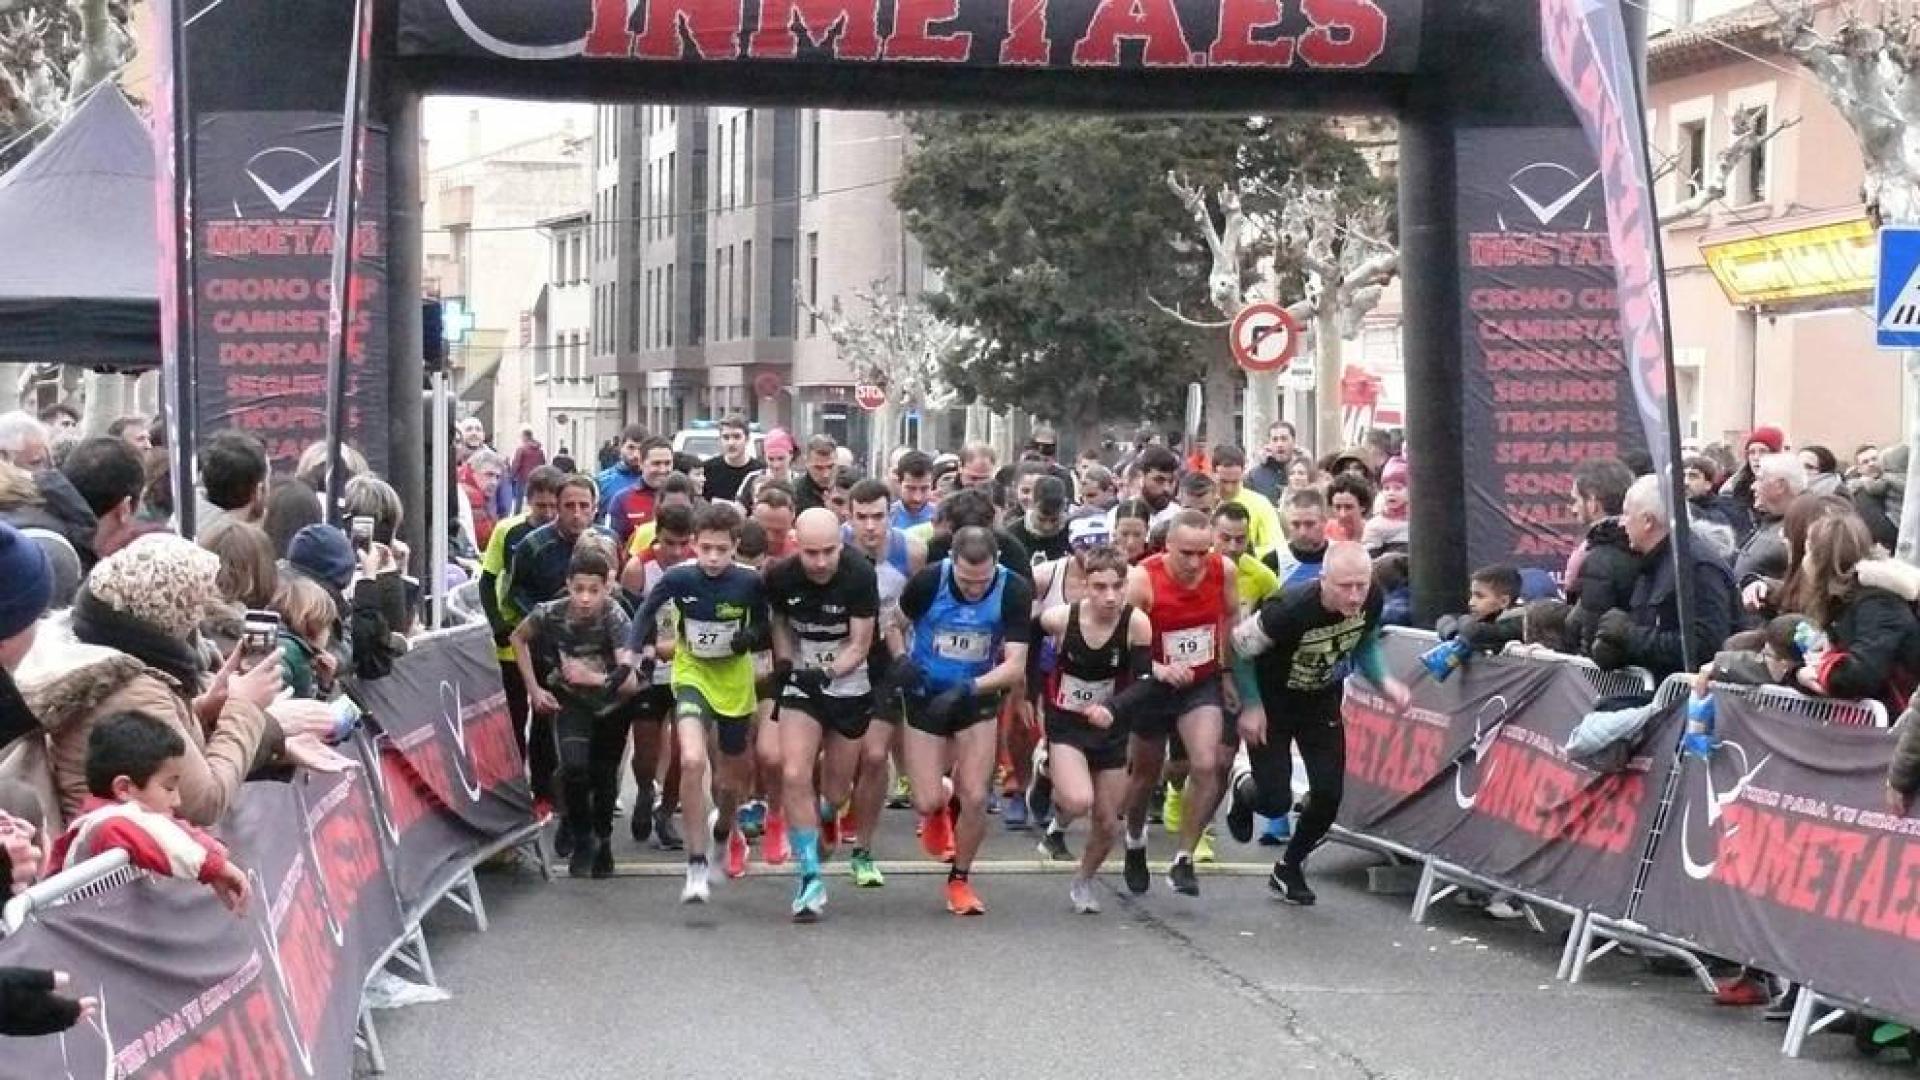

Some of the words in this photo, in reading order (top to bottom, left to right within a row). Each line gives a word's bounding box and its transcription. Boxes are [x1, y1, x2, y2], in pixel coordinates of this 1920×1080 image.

[206, 279, 310, 301] CRONO
[1471, 288, 1574, 311] CRONO
[1578, 288, 1618, 311] CH
[213, 310, 371, 334] CAMISETS
[219, 343, 366, 365] DORSALS
[1493, 380, 1617, 402] SEGUROS
[1494, 410, 1617, 433] TROFEOS
[698, 633, 719, 645] 27
[1178, 640, 1198, 655] 19
